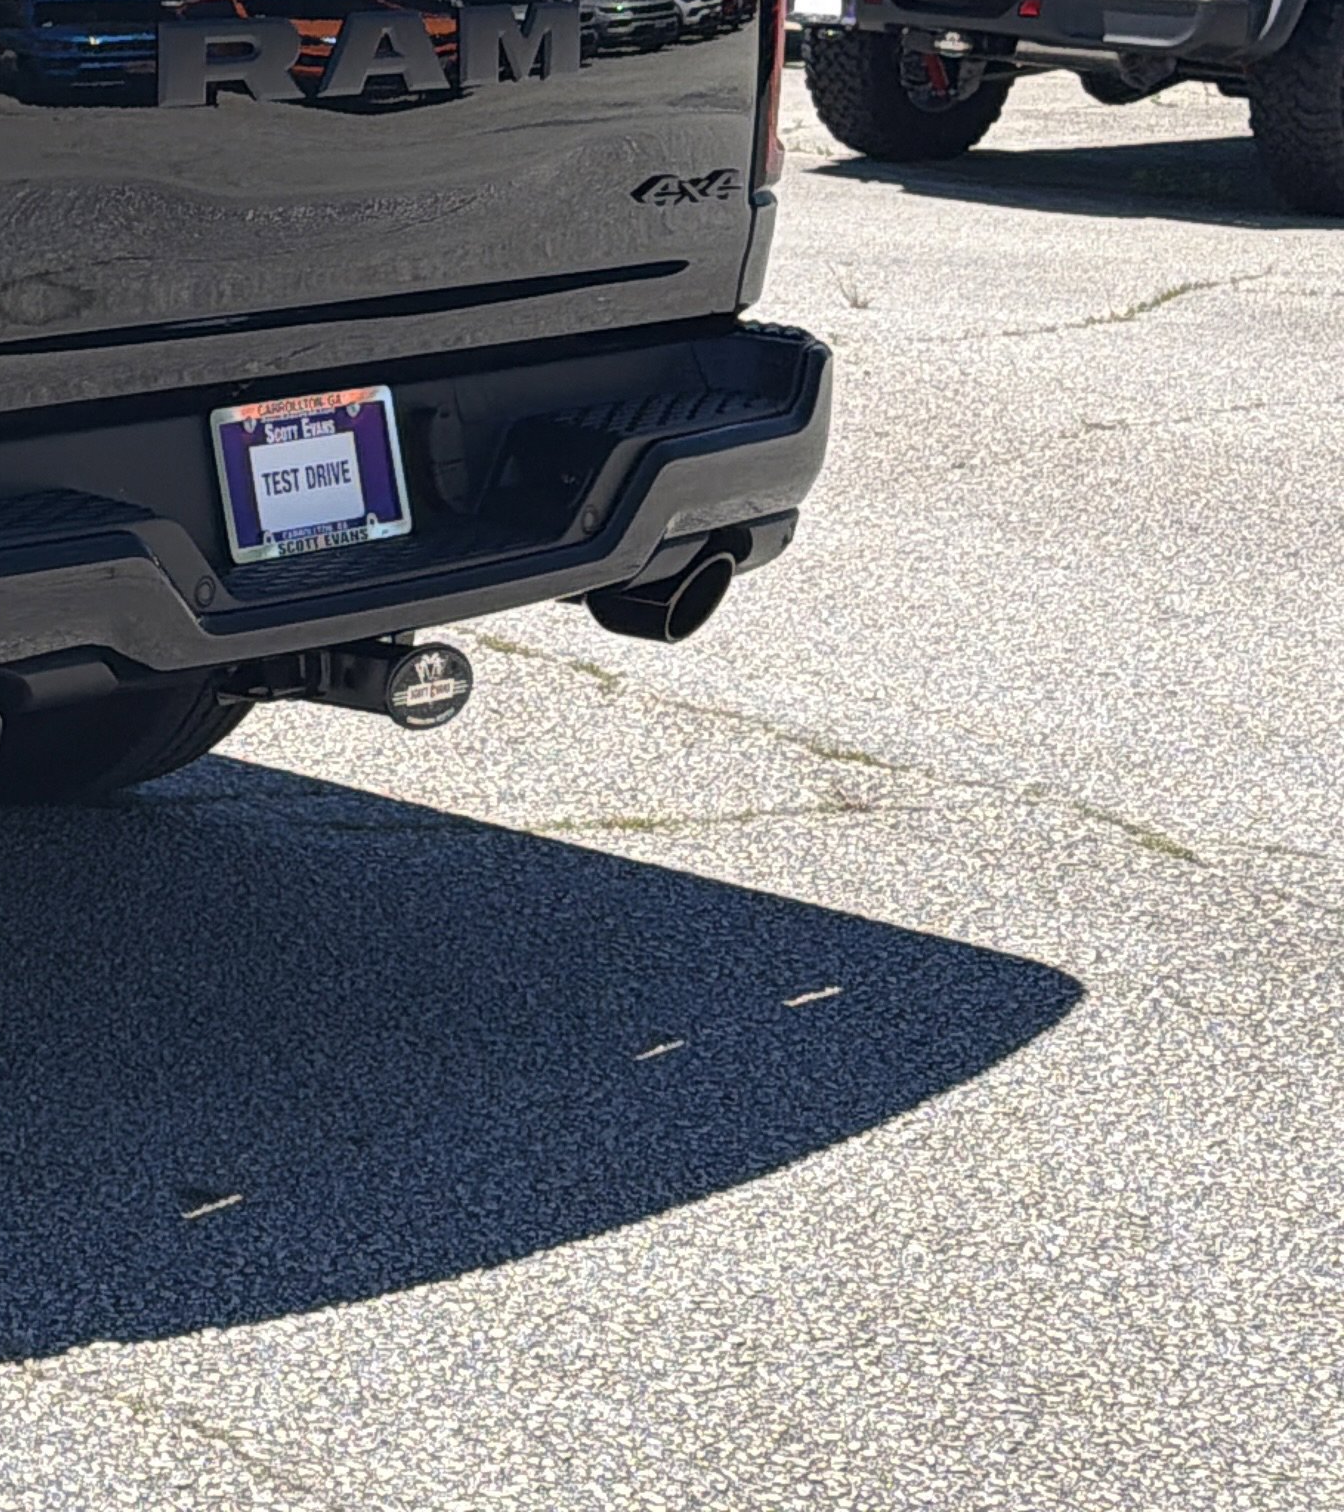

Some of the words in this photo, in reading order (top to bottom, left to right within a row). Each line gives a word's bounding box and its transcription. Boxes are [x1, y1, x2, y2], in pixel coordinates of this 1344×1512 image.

[157, 0, 581, 107] RAM
[261, 468, 300, 496] TEST
[305, 459, 352, 489] DRIVE
[278, 538, 322, 555] SCOTT
[325, 529, 369, 546] EVANS
